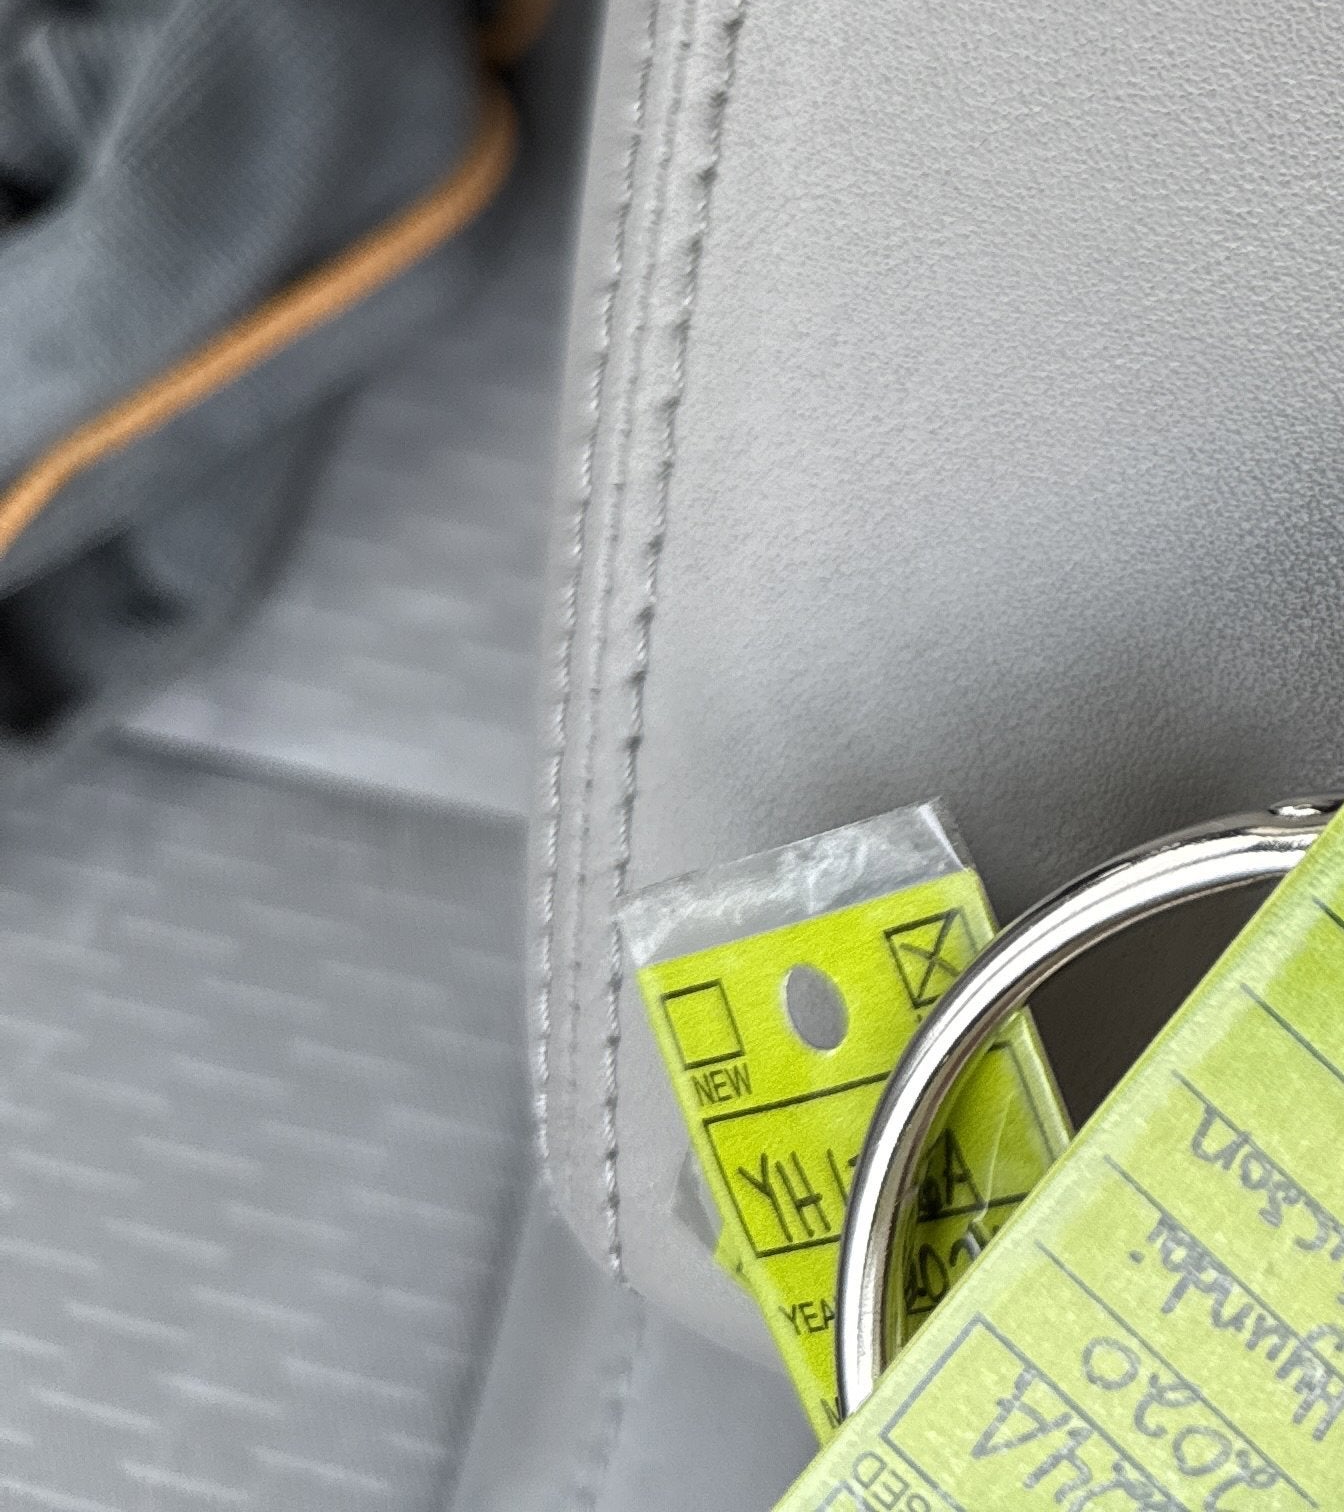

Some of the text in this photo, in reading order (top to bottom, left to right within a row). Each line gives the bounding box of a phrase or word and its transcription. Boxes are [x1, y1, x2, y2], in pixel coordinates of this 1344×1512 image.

[693, 1064, 753, 1108] NEW
[778, 1296, 836, 1336] YEA
[852, 1450, 931, 1512] SED
